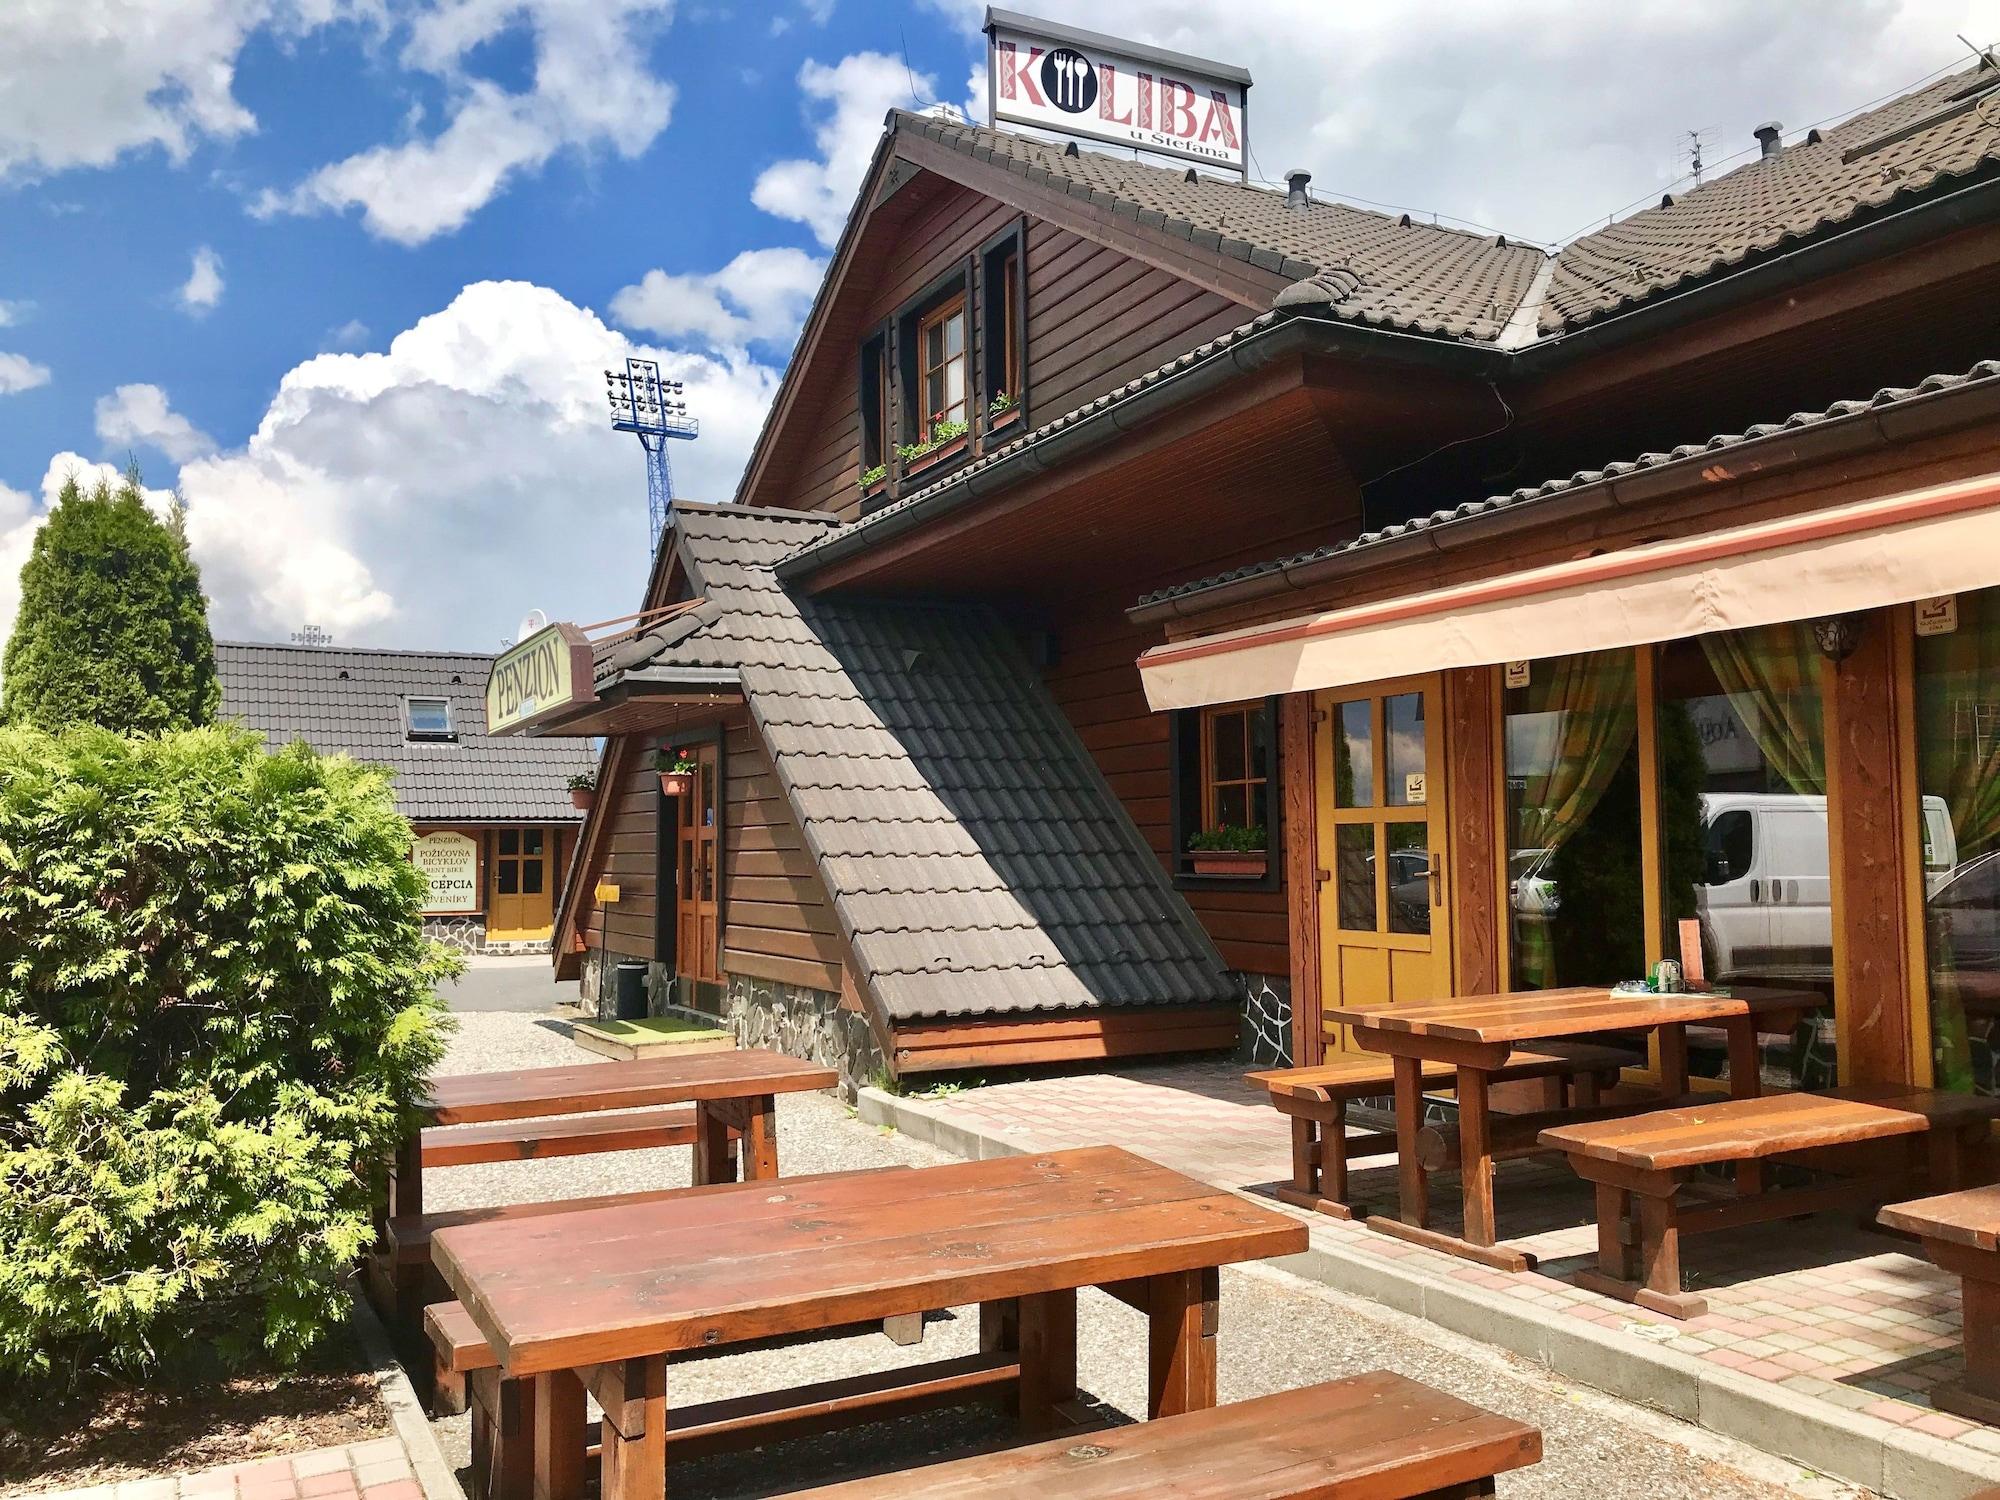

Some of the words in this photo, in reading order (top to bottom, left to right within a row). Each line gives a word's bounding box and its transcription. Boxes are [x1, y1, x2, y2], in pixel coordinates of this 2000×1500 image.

[999, 41, 1240, 150] KOLIBA
[1129, 130, 1143, 141] u
[1151, 132, 1230, 160] Štefana
[496, 636, 560, 719] PENZION
[420, 849, 470, 857] POŽIČOVŇA
[423, 858, 468, 866] BICYKLOV
